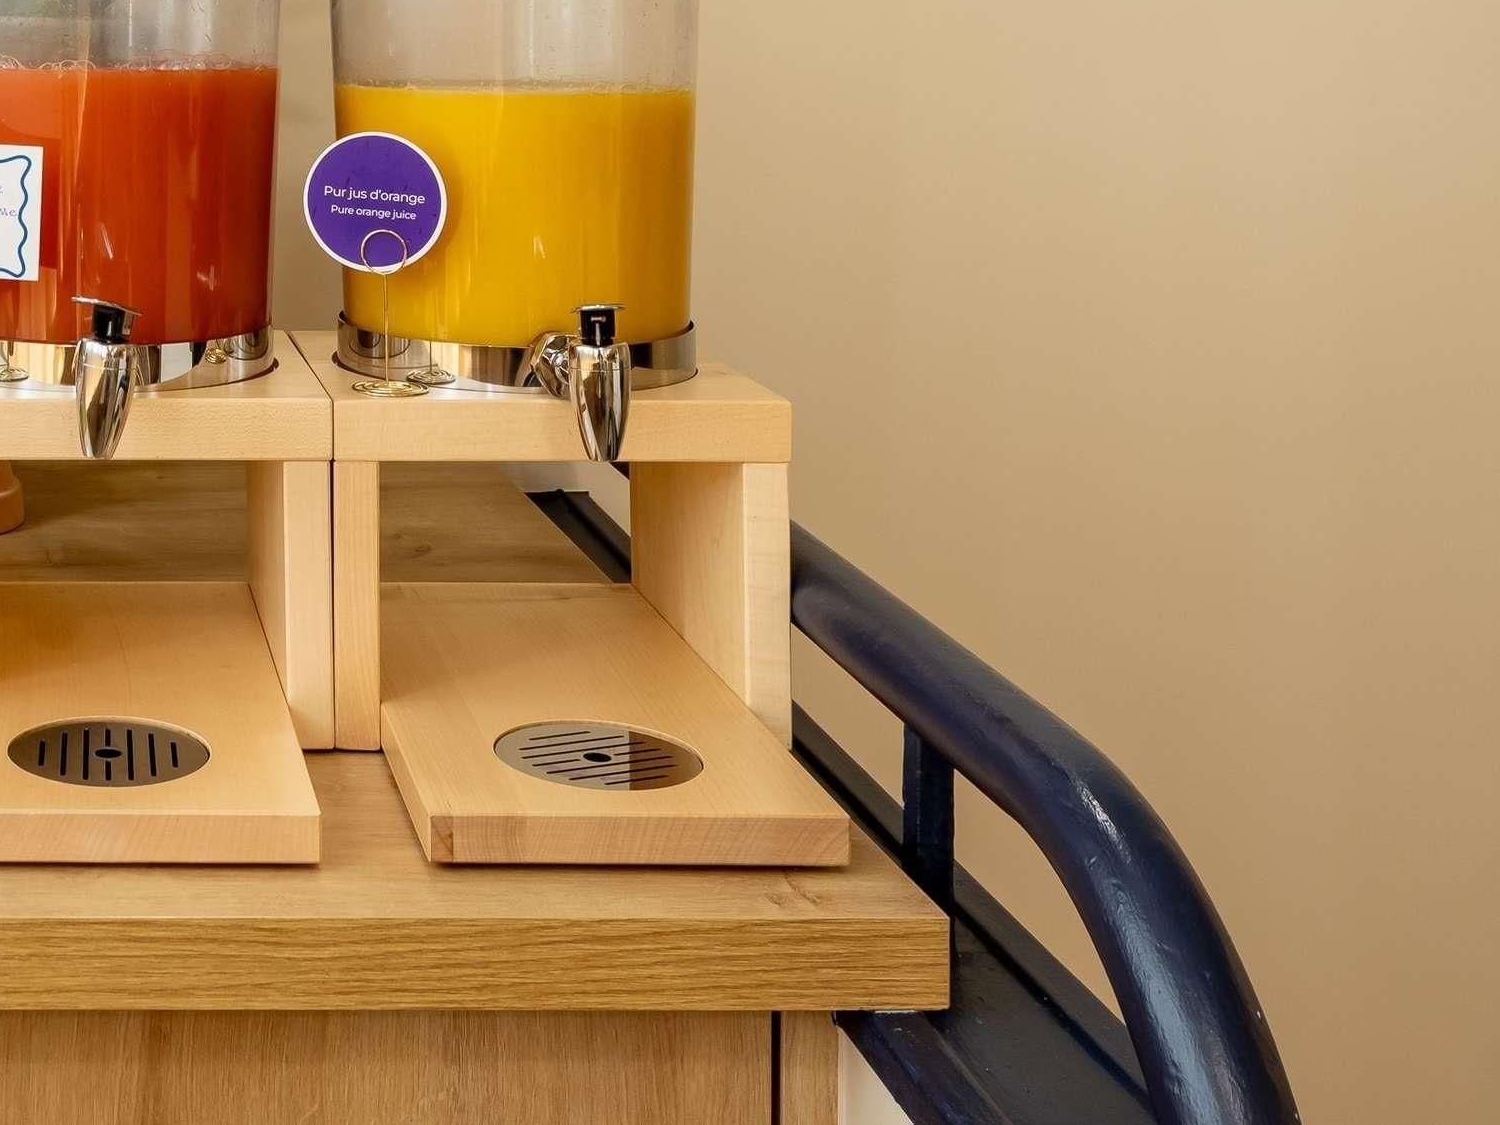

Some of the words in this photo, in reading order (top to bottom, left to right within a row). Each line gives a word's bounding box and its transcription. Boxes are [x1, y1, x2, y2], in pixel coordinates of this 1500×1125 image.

[324, 185, 346, 197] Pur
[347, 187, 367, 201] jus
[369, 189, 426, 206] d'orange
[331, 204, 354, 215] Pure
[355, 207, 391, 220] orange
[391, 209, 417, 220] juice
